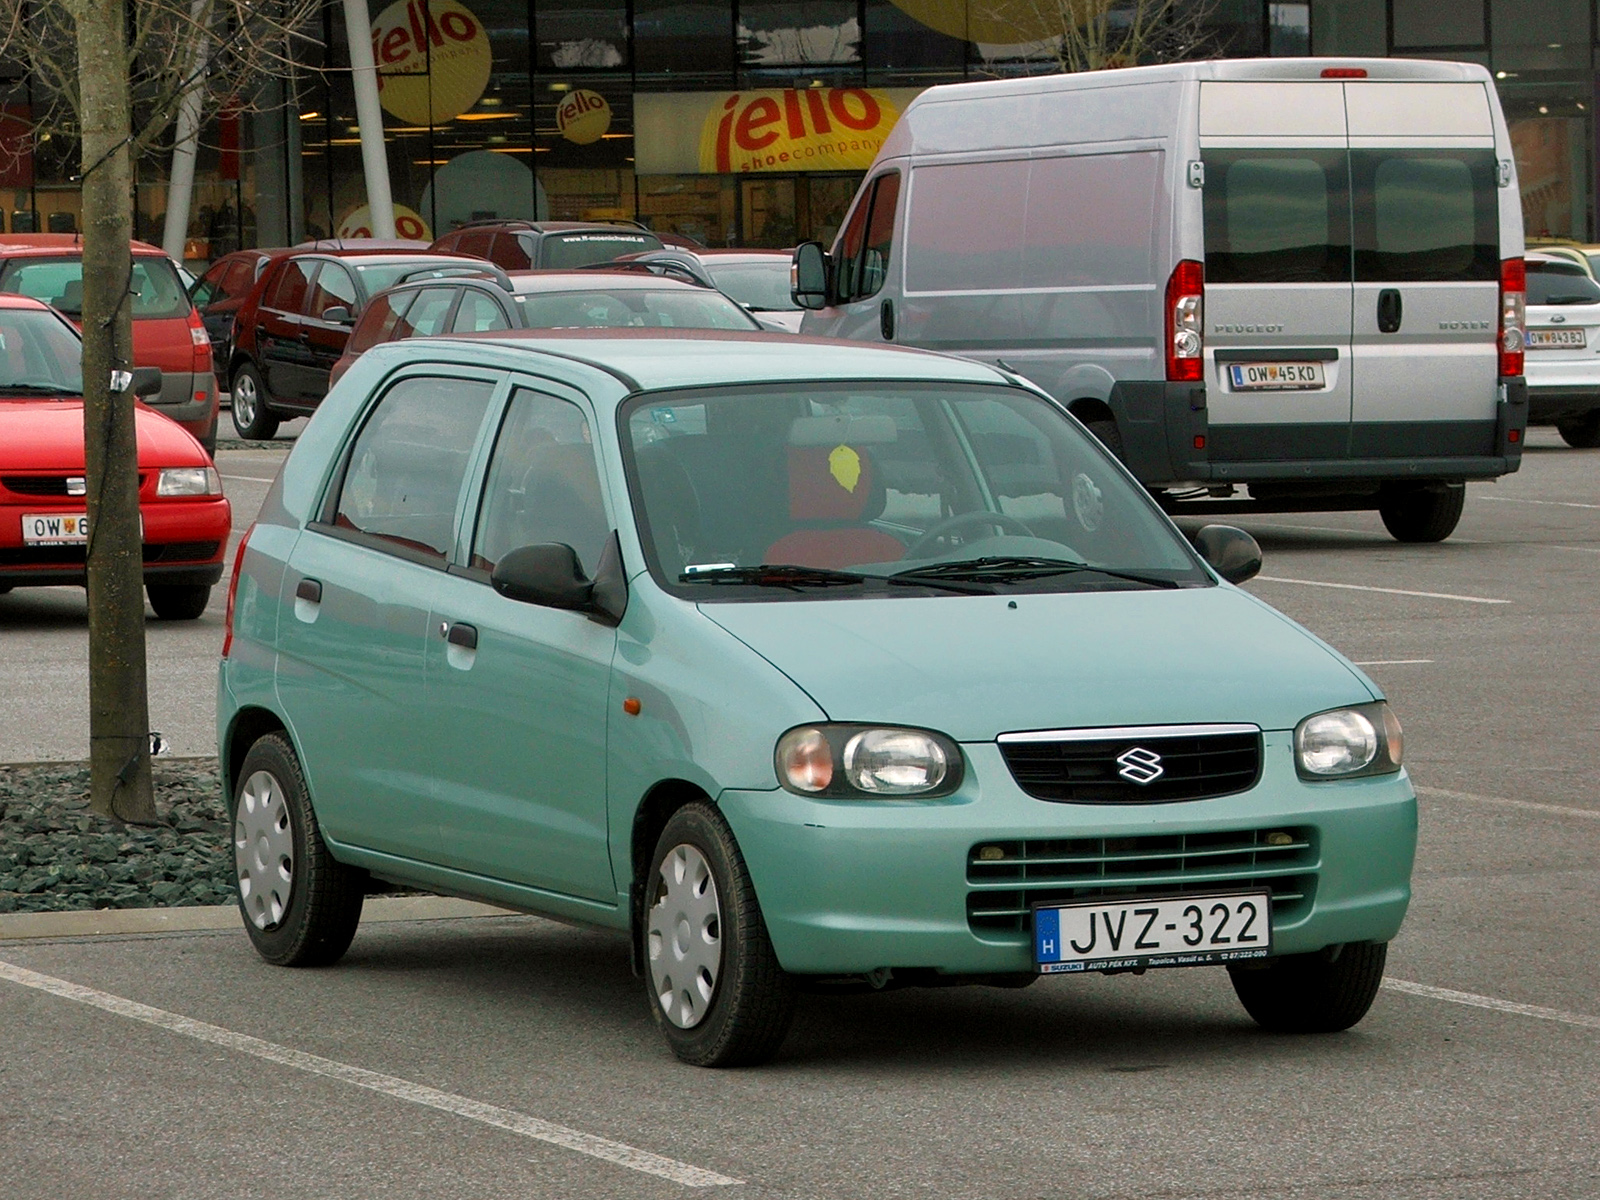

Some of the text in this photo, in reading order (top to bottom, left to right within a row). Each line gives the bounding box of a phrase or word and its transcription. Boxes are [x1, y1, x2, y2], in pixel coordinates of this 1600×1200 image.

[1214, 323, 1284, 333] PEUGEOT
[1439, 321, 1490, 330] BOXER
[1247, 366, 1268, 382] OW
[35, 518, 60, 537] OW
[1070, 901, 1258, 954] JVZ-322
[1042, 939, 1054, 954] H
[1050, 963, 1082, 971] SUZUKI
[1088, 962, 1107, 970] AUTO
